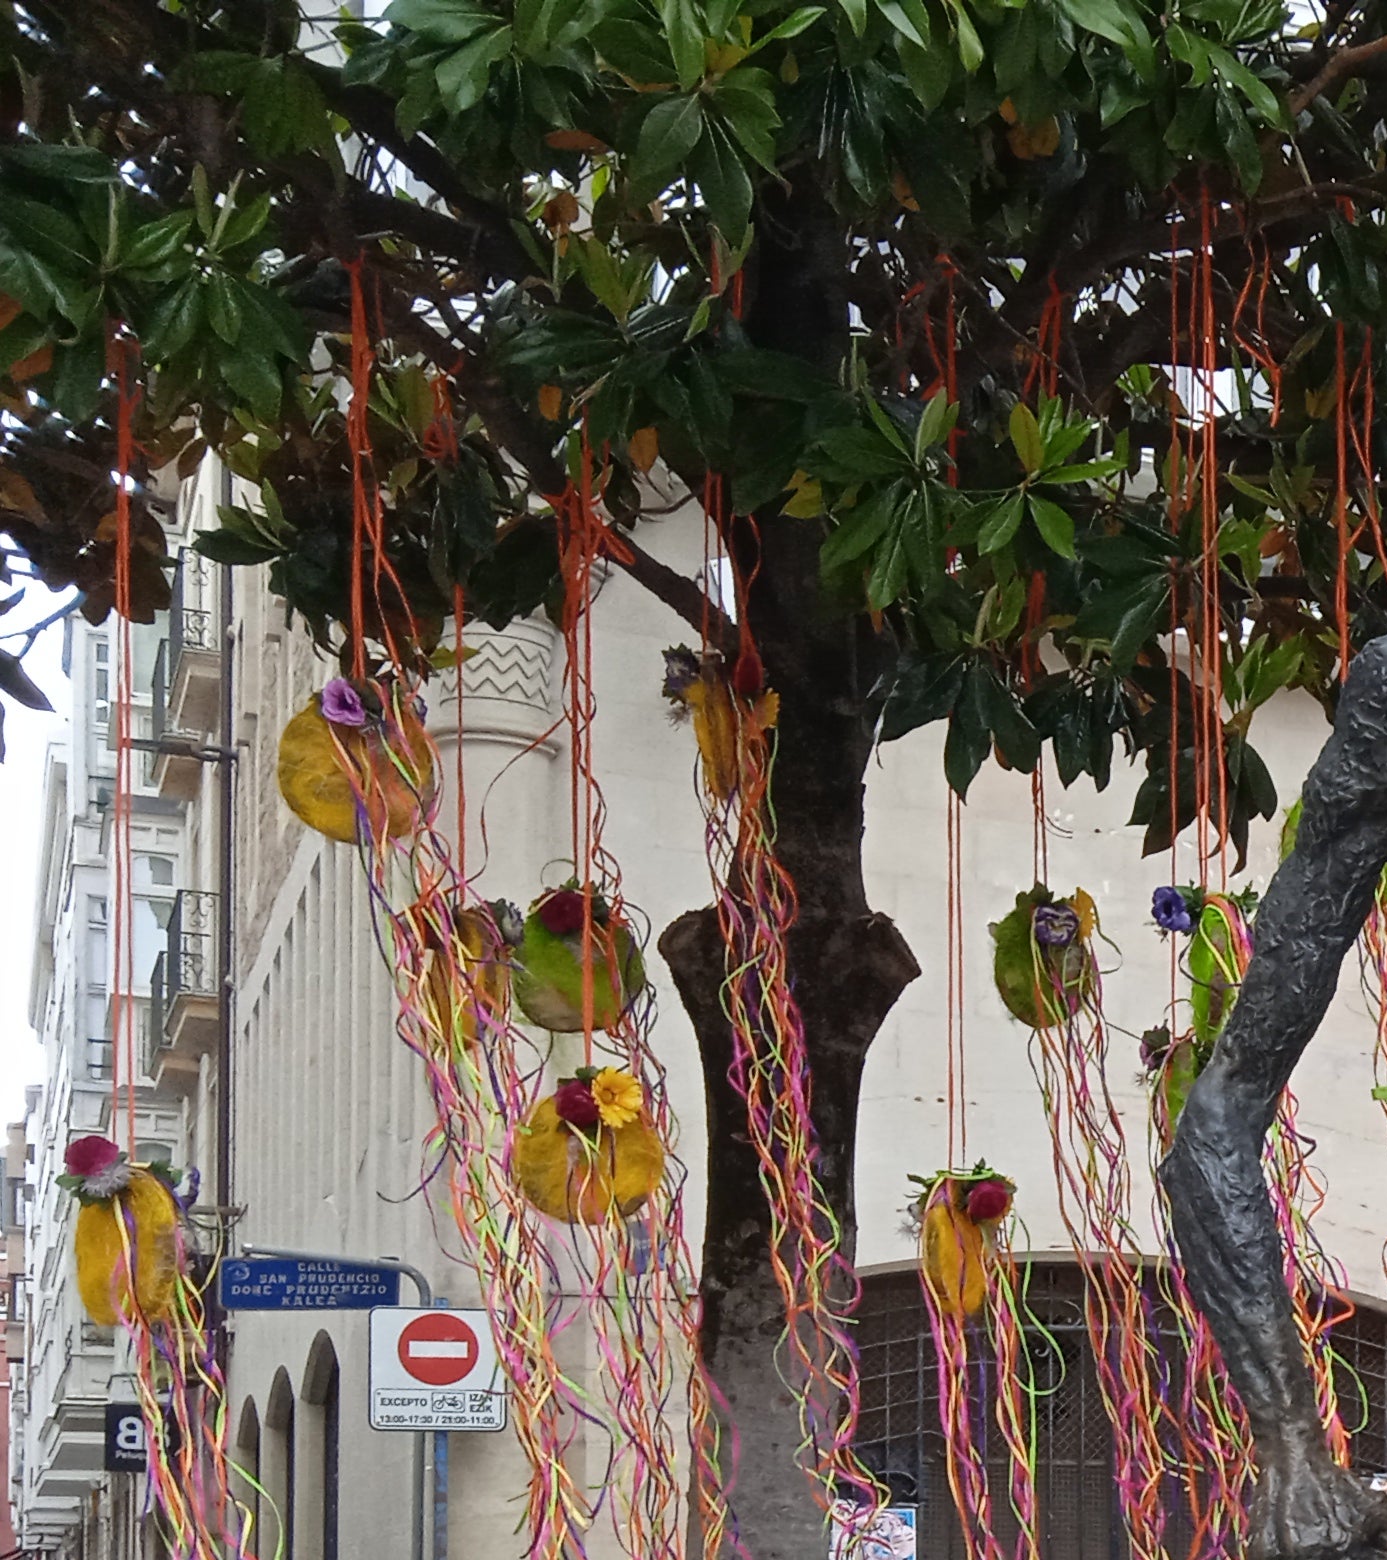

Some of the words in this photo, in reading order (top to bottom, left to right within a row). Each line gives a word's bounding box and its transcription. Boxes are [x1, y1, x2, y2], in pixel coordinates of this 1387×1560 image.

[297, 1262, 341, 1272] CALLE
[259, 1273, 287, 1284] SAN
[298, 1273, 380, 1284] PRUDENCIO
[231, 1284, 273, 1296] DONE
[286, 1284, 388, 1295] PRUDENTZIO
[281, 1296, 338, 1306] KALEA
[380, 1397, 428, 1406] EXCEPTO
